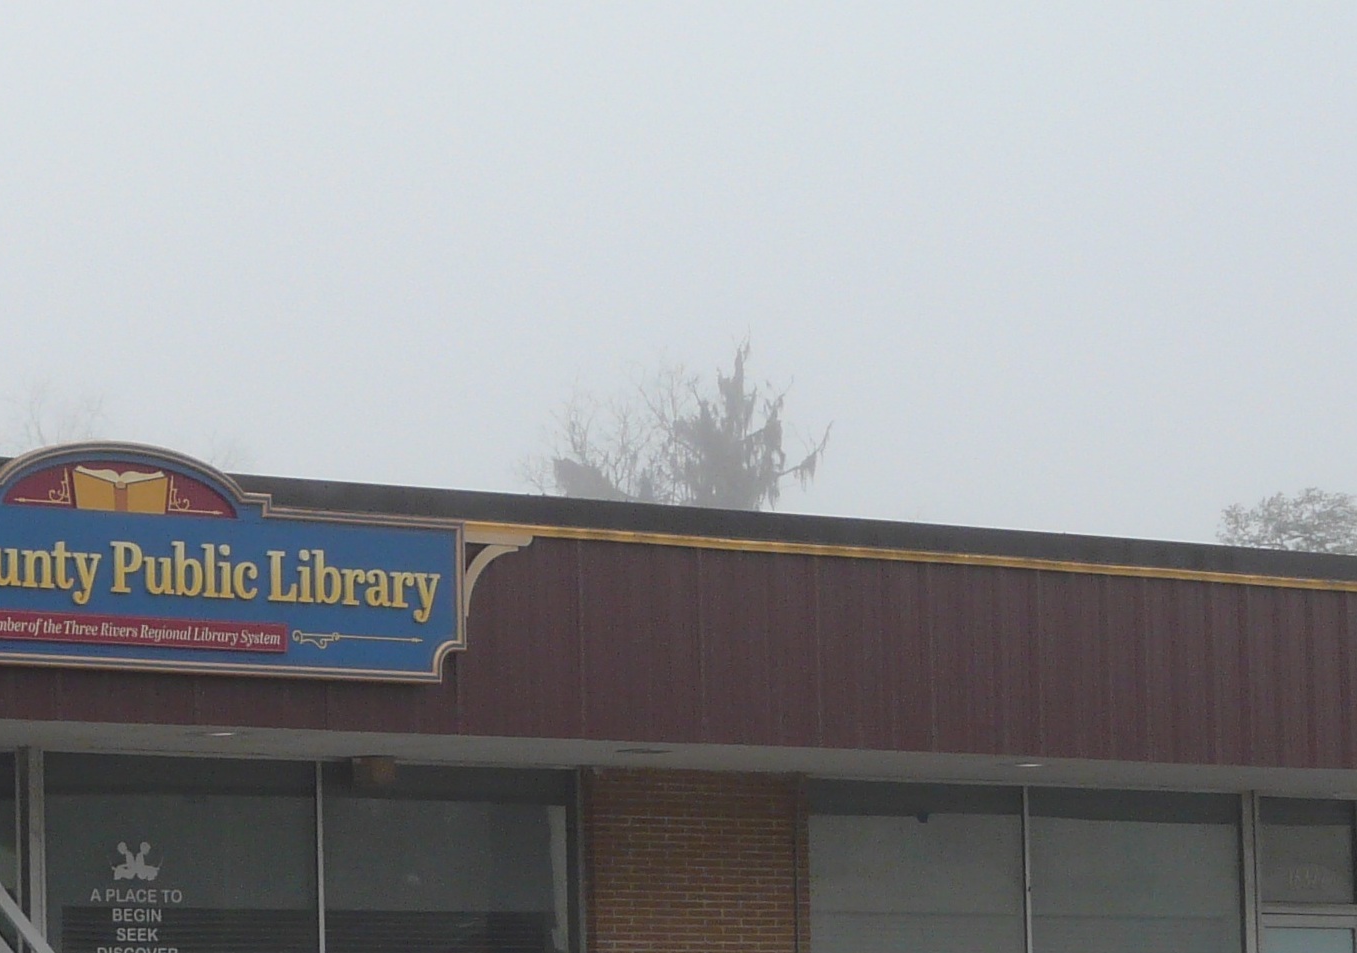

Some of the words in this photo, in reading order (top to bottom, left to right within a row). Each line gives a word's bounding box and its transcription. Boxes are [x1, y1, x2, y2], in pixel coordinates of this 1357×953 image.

[109, 540, 259, 600] Public
[266, 549, 441, 624] Library
[29, 618, 44, 637] of
[44, 619, 63, 634] the
[63, 620, 99, 636] Three
[101, 621, 138, 639] Rivers
[140, 624, 191, 643] Regional
[193, 627, 239, 646] Library
[240, 629, 280, 647] System
[90, 888, 102, 902] A
[105, 888, 157, 903] PLACE
[161, 889, 183, 903] TO
[112, 908, 163, 923] BEGIN
[116, 927, 159, 942] SEEK
